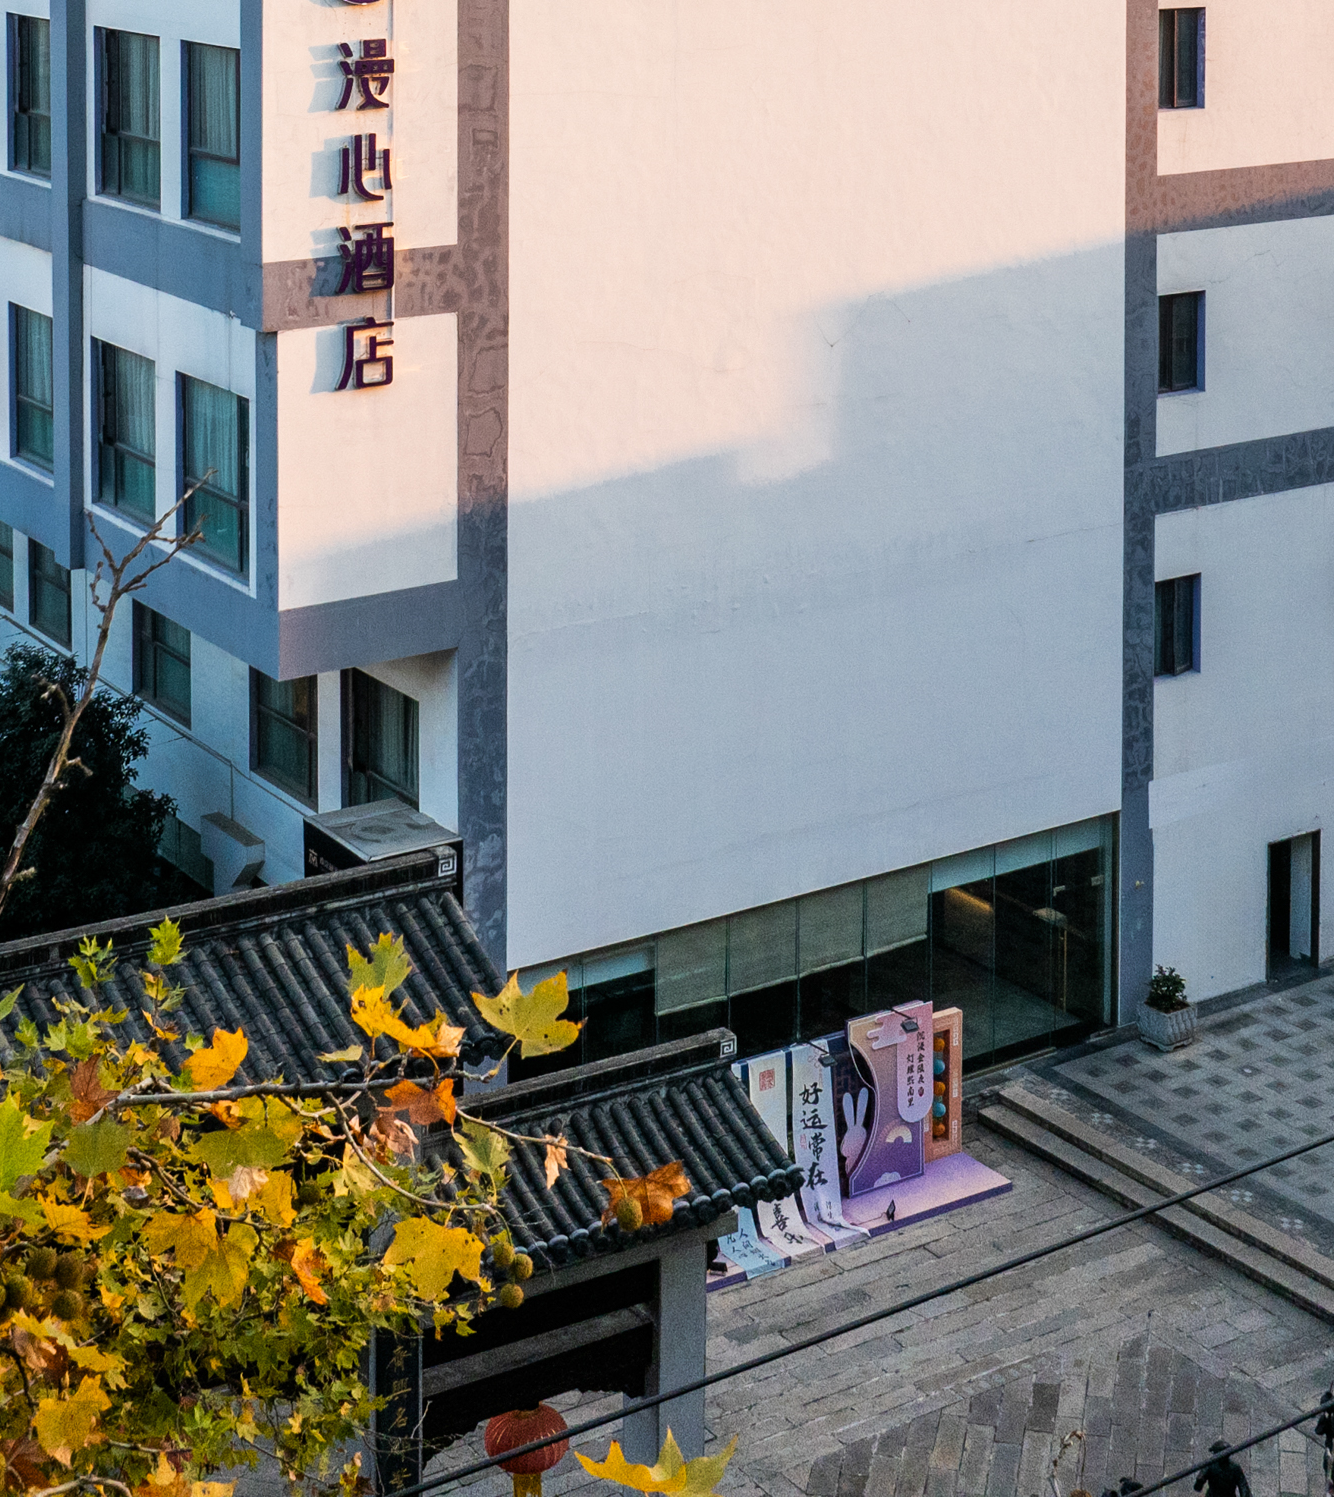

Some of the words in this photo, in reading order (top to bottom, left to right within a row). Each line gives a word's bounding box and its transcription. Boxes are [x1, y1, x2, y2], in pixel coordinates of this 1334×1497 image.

[335, 38, 395, 392] 漫心酒店
[798, 1081, 829, 1190] 好运常在
